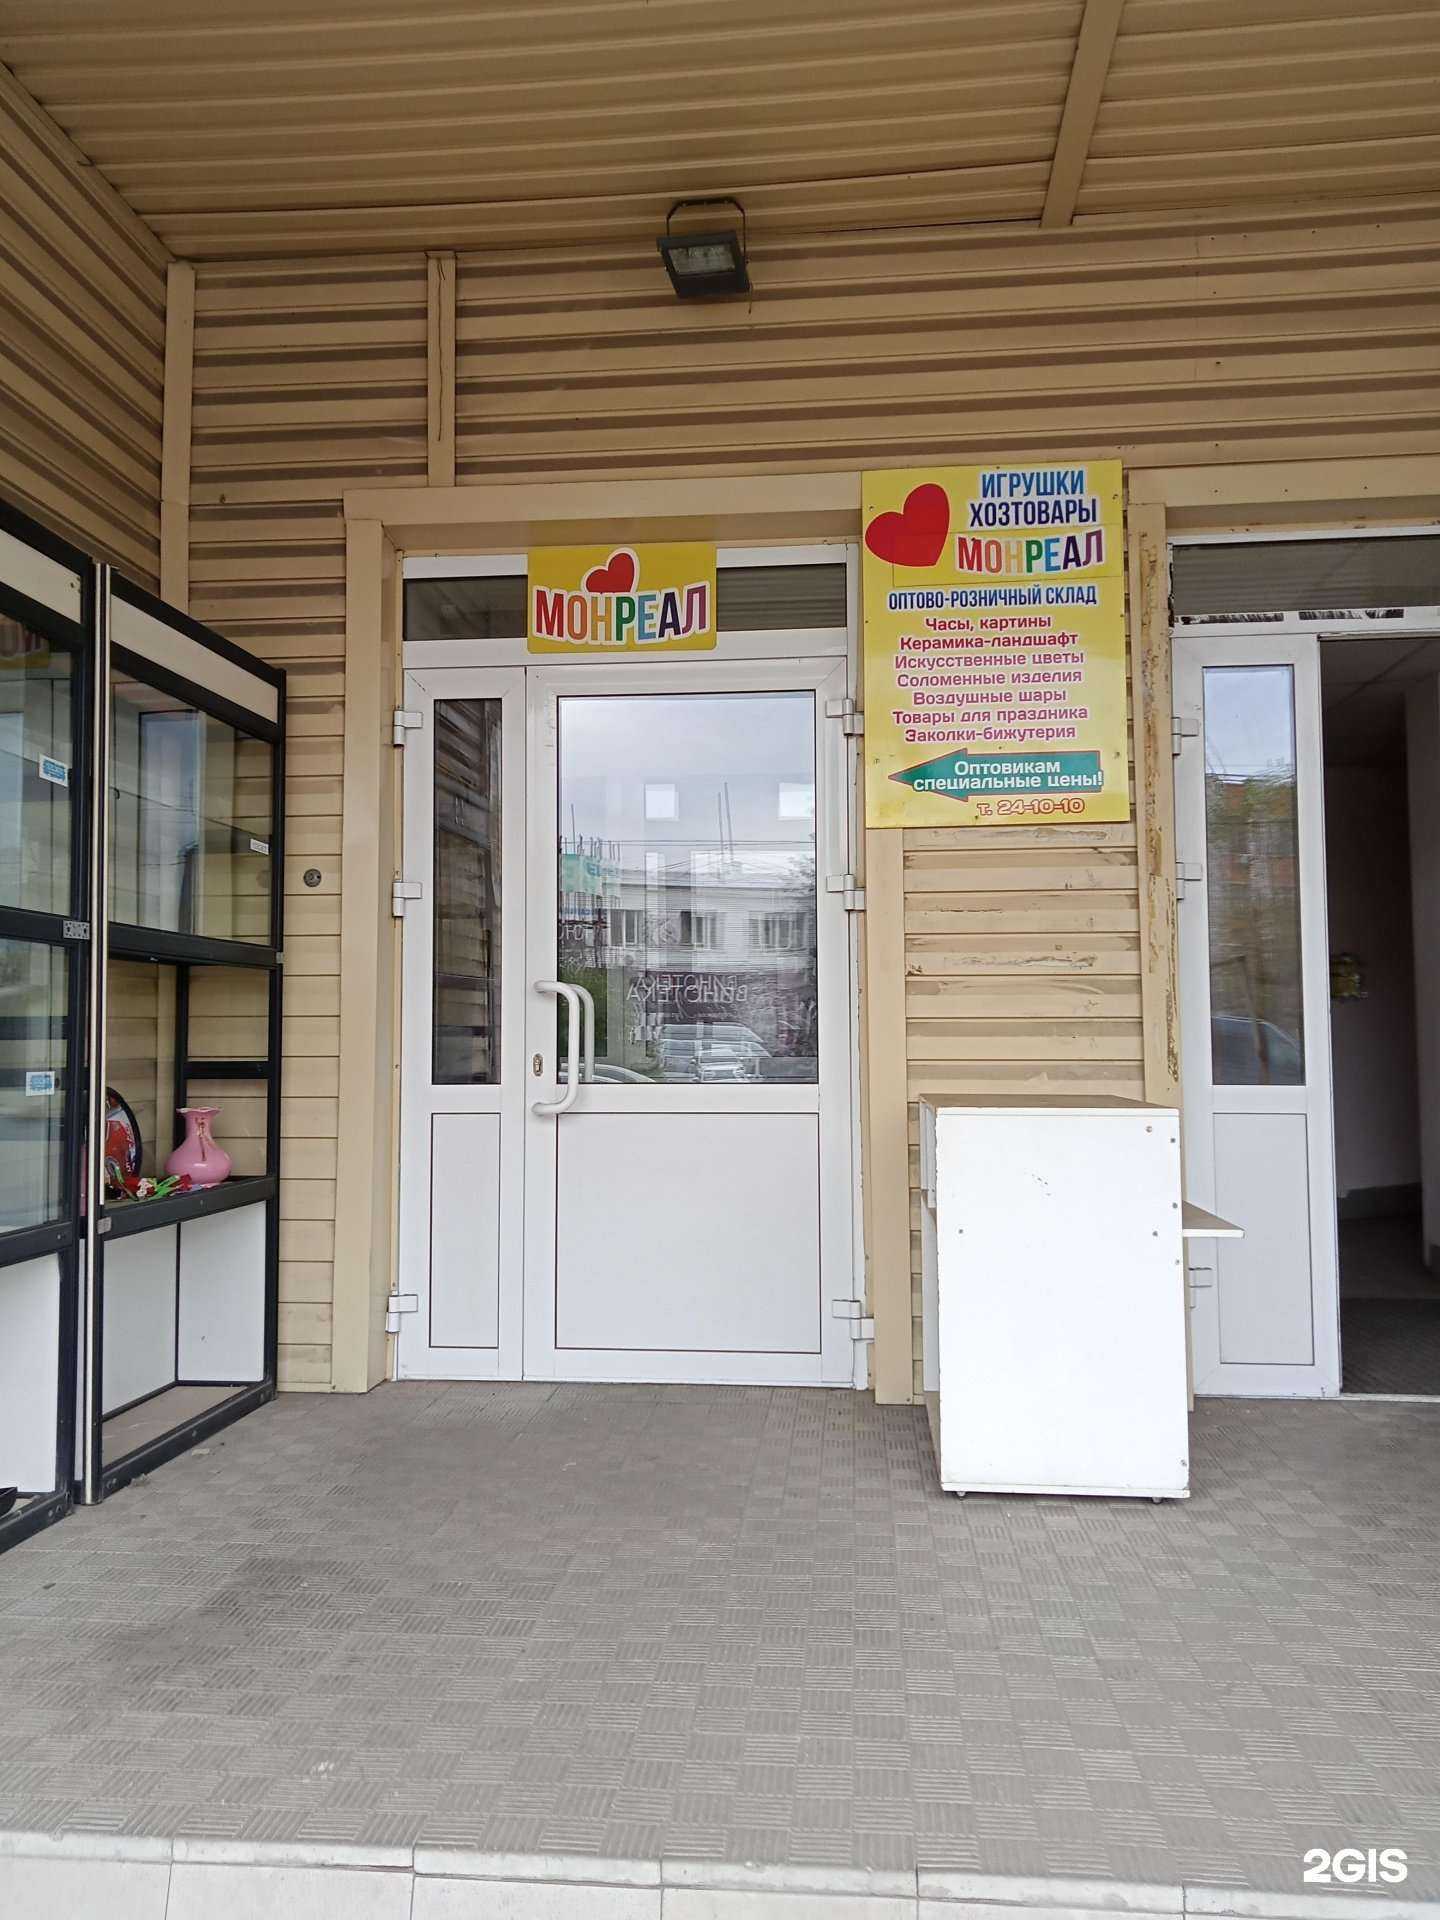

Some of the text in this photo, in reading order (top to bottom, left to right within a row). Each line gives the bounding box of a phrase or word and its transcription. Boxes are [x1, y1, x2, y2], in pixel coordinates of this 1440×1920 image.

[982, 470, 1085, 498] ИГРУШКИ
[969, 498, 1097, 527] ХОЗТОВАРЫ
[957, 529, 1104, 574] МОНРЕАЛ
[888, 584, 1097, 610] ОПТОВО-РОЗНИЧНЫЙ СКЛАД
[535, 584, 707, 642] МОНРЕАЛ
[925, 616, 1051, 631] Часы, картины
[900, 632, 1078, 652] Керамика-ландшафт
[895, 651, 1084, 671] Искусственные цветы
[897, 670, 1082, 687] Соломенные изделия
[913, 690, 1066, 706] Воздушные шары
[892, 707, 1088, 726] Товары для праздника
[905, 725, 1076, 742] Заколки-бижутерия
[954, 760, 1061, 776] Оптовикам
[913, 770, 1104, 791] специальные цены!
[977, 798, 1085, 816] т. 24-10-10
